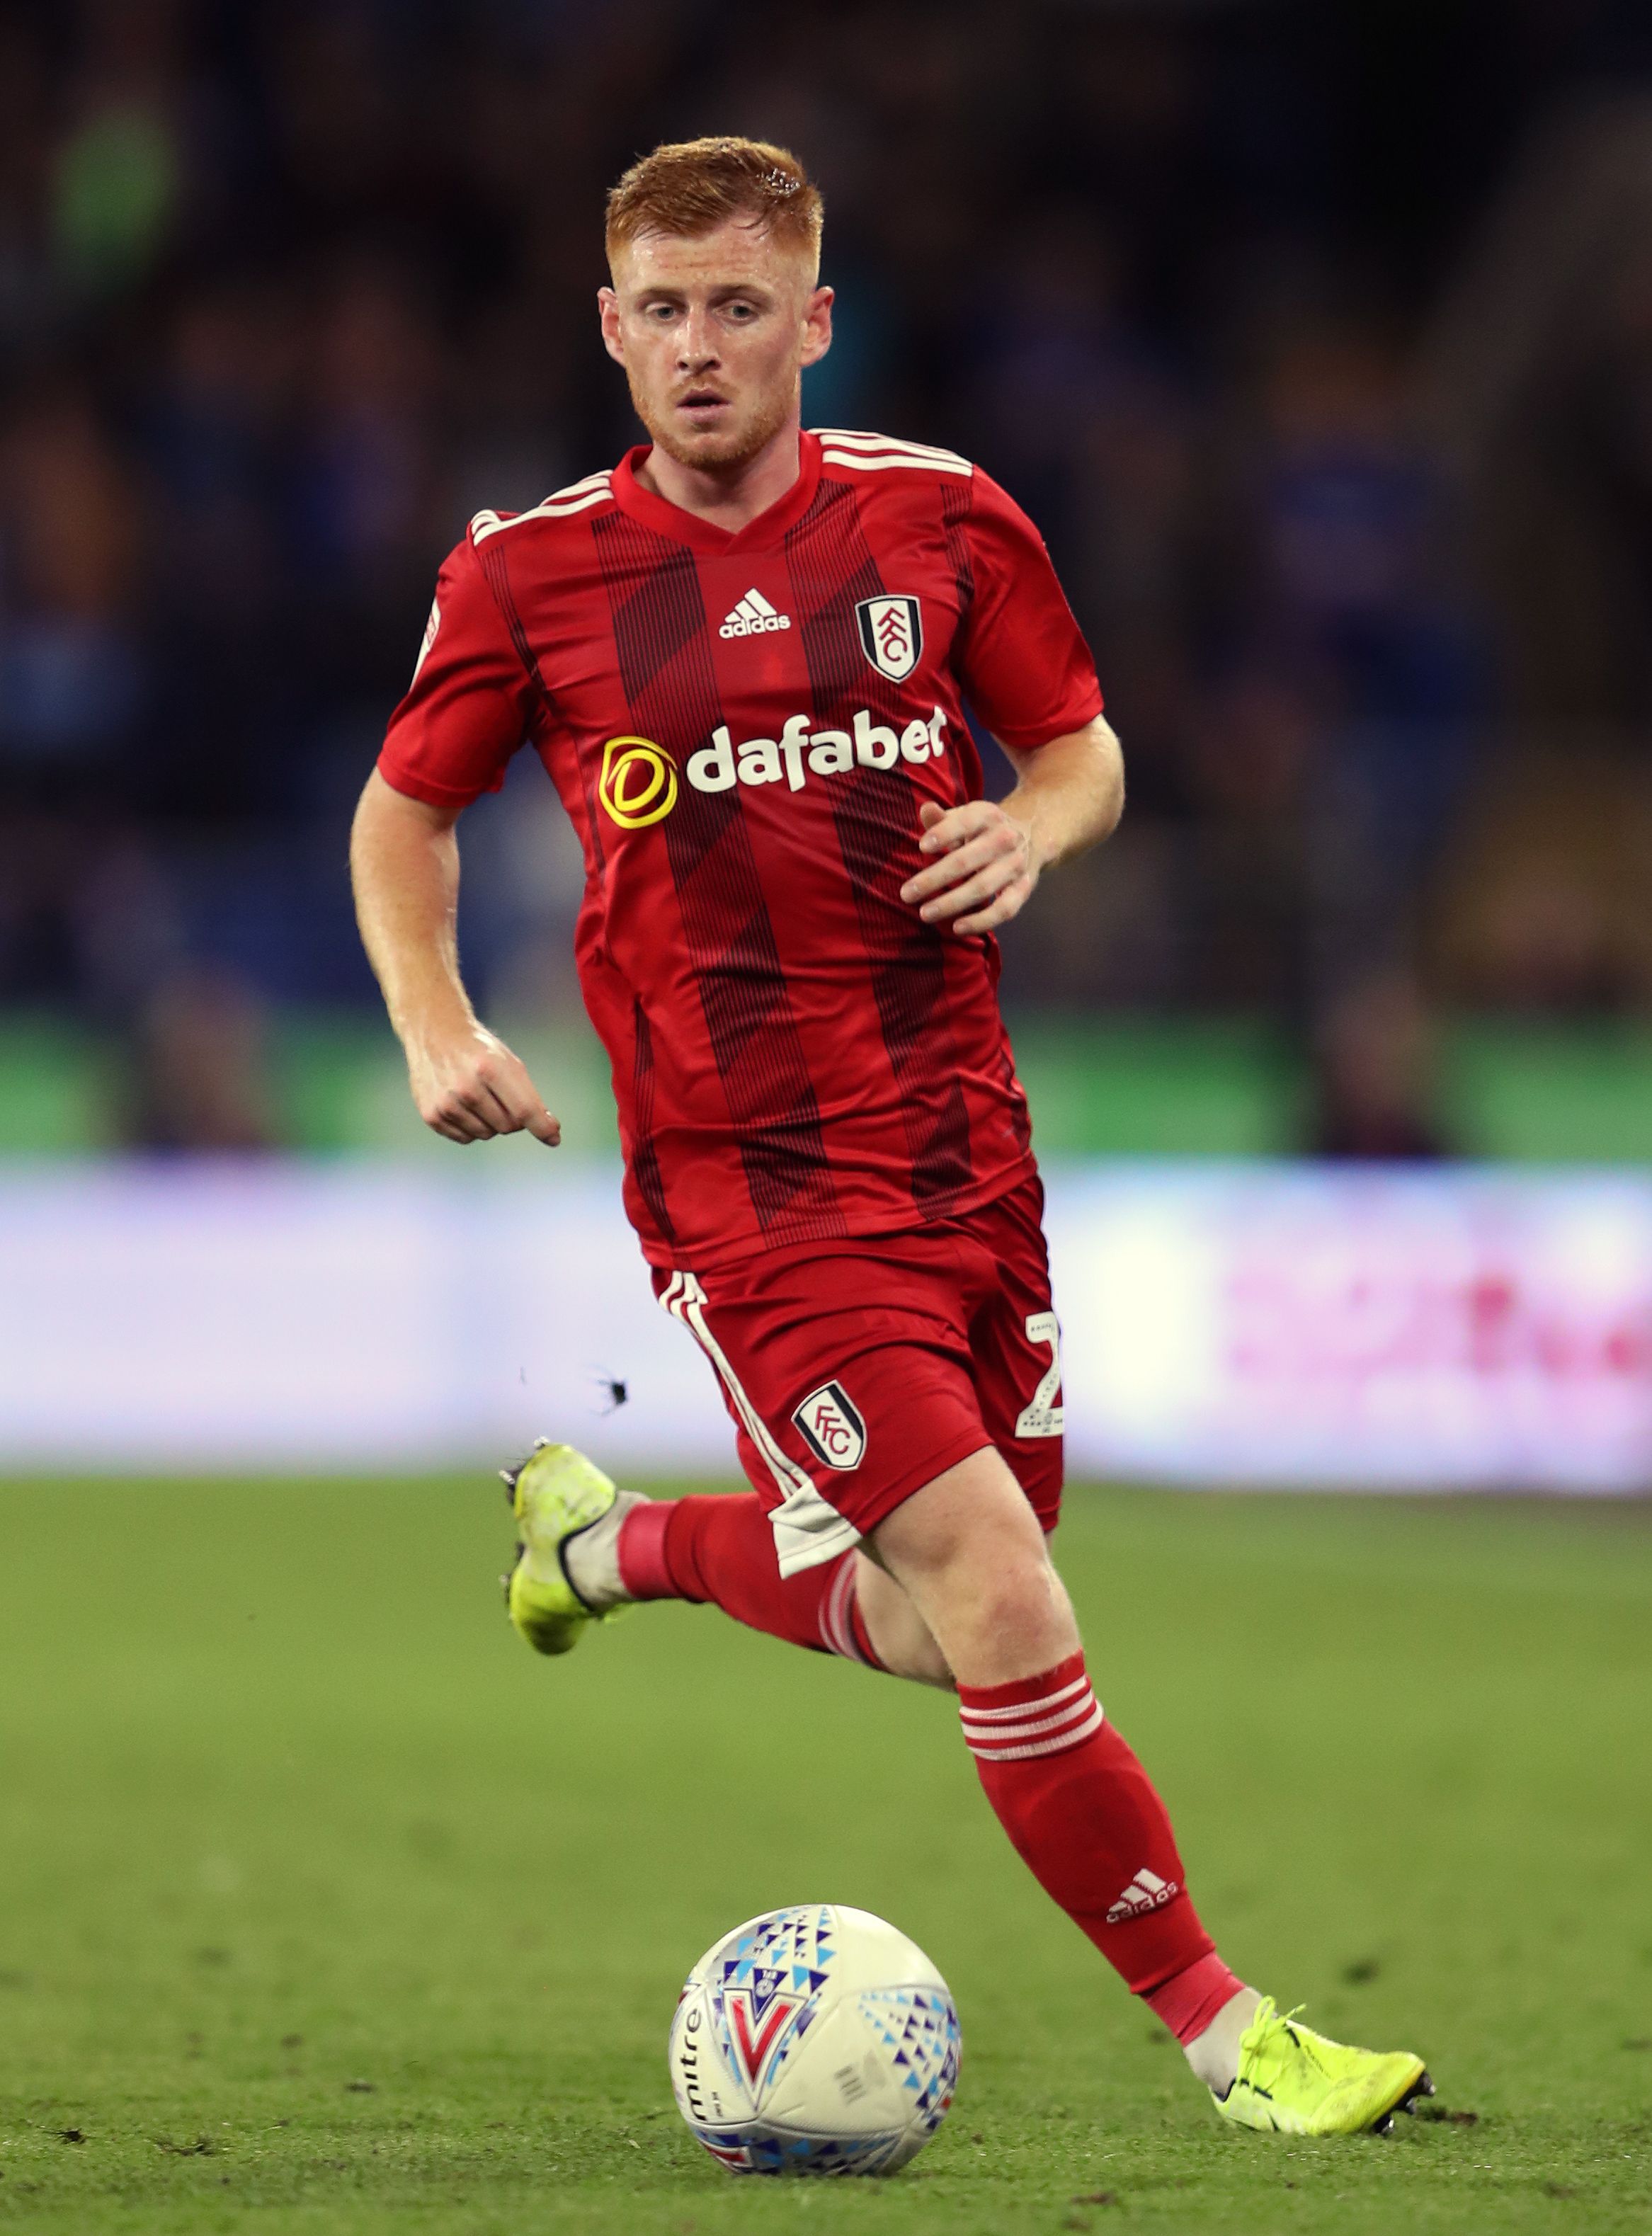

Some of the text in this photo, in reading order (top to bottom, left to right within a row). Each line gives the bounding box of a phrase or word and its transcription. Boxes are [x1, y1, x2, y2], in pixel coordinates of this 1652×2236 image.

[718, 615, 792, 639] adidas
[686, 706, 947, 793] dafabet
[1106, 1881, 1178, 1924] adidas
[680, 2008, 707, 2121] mitre
